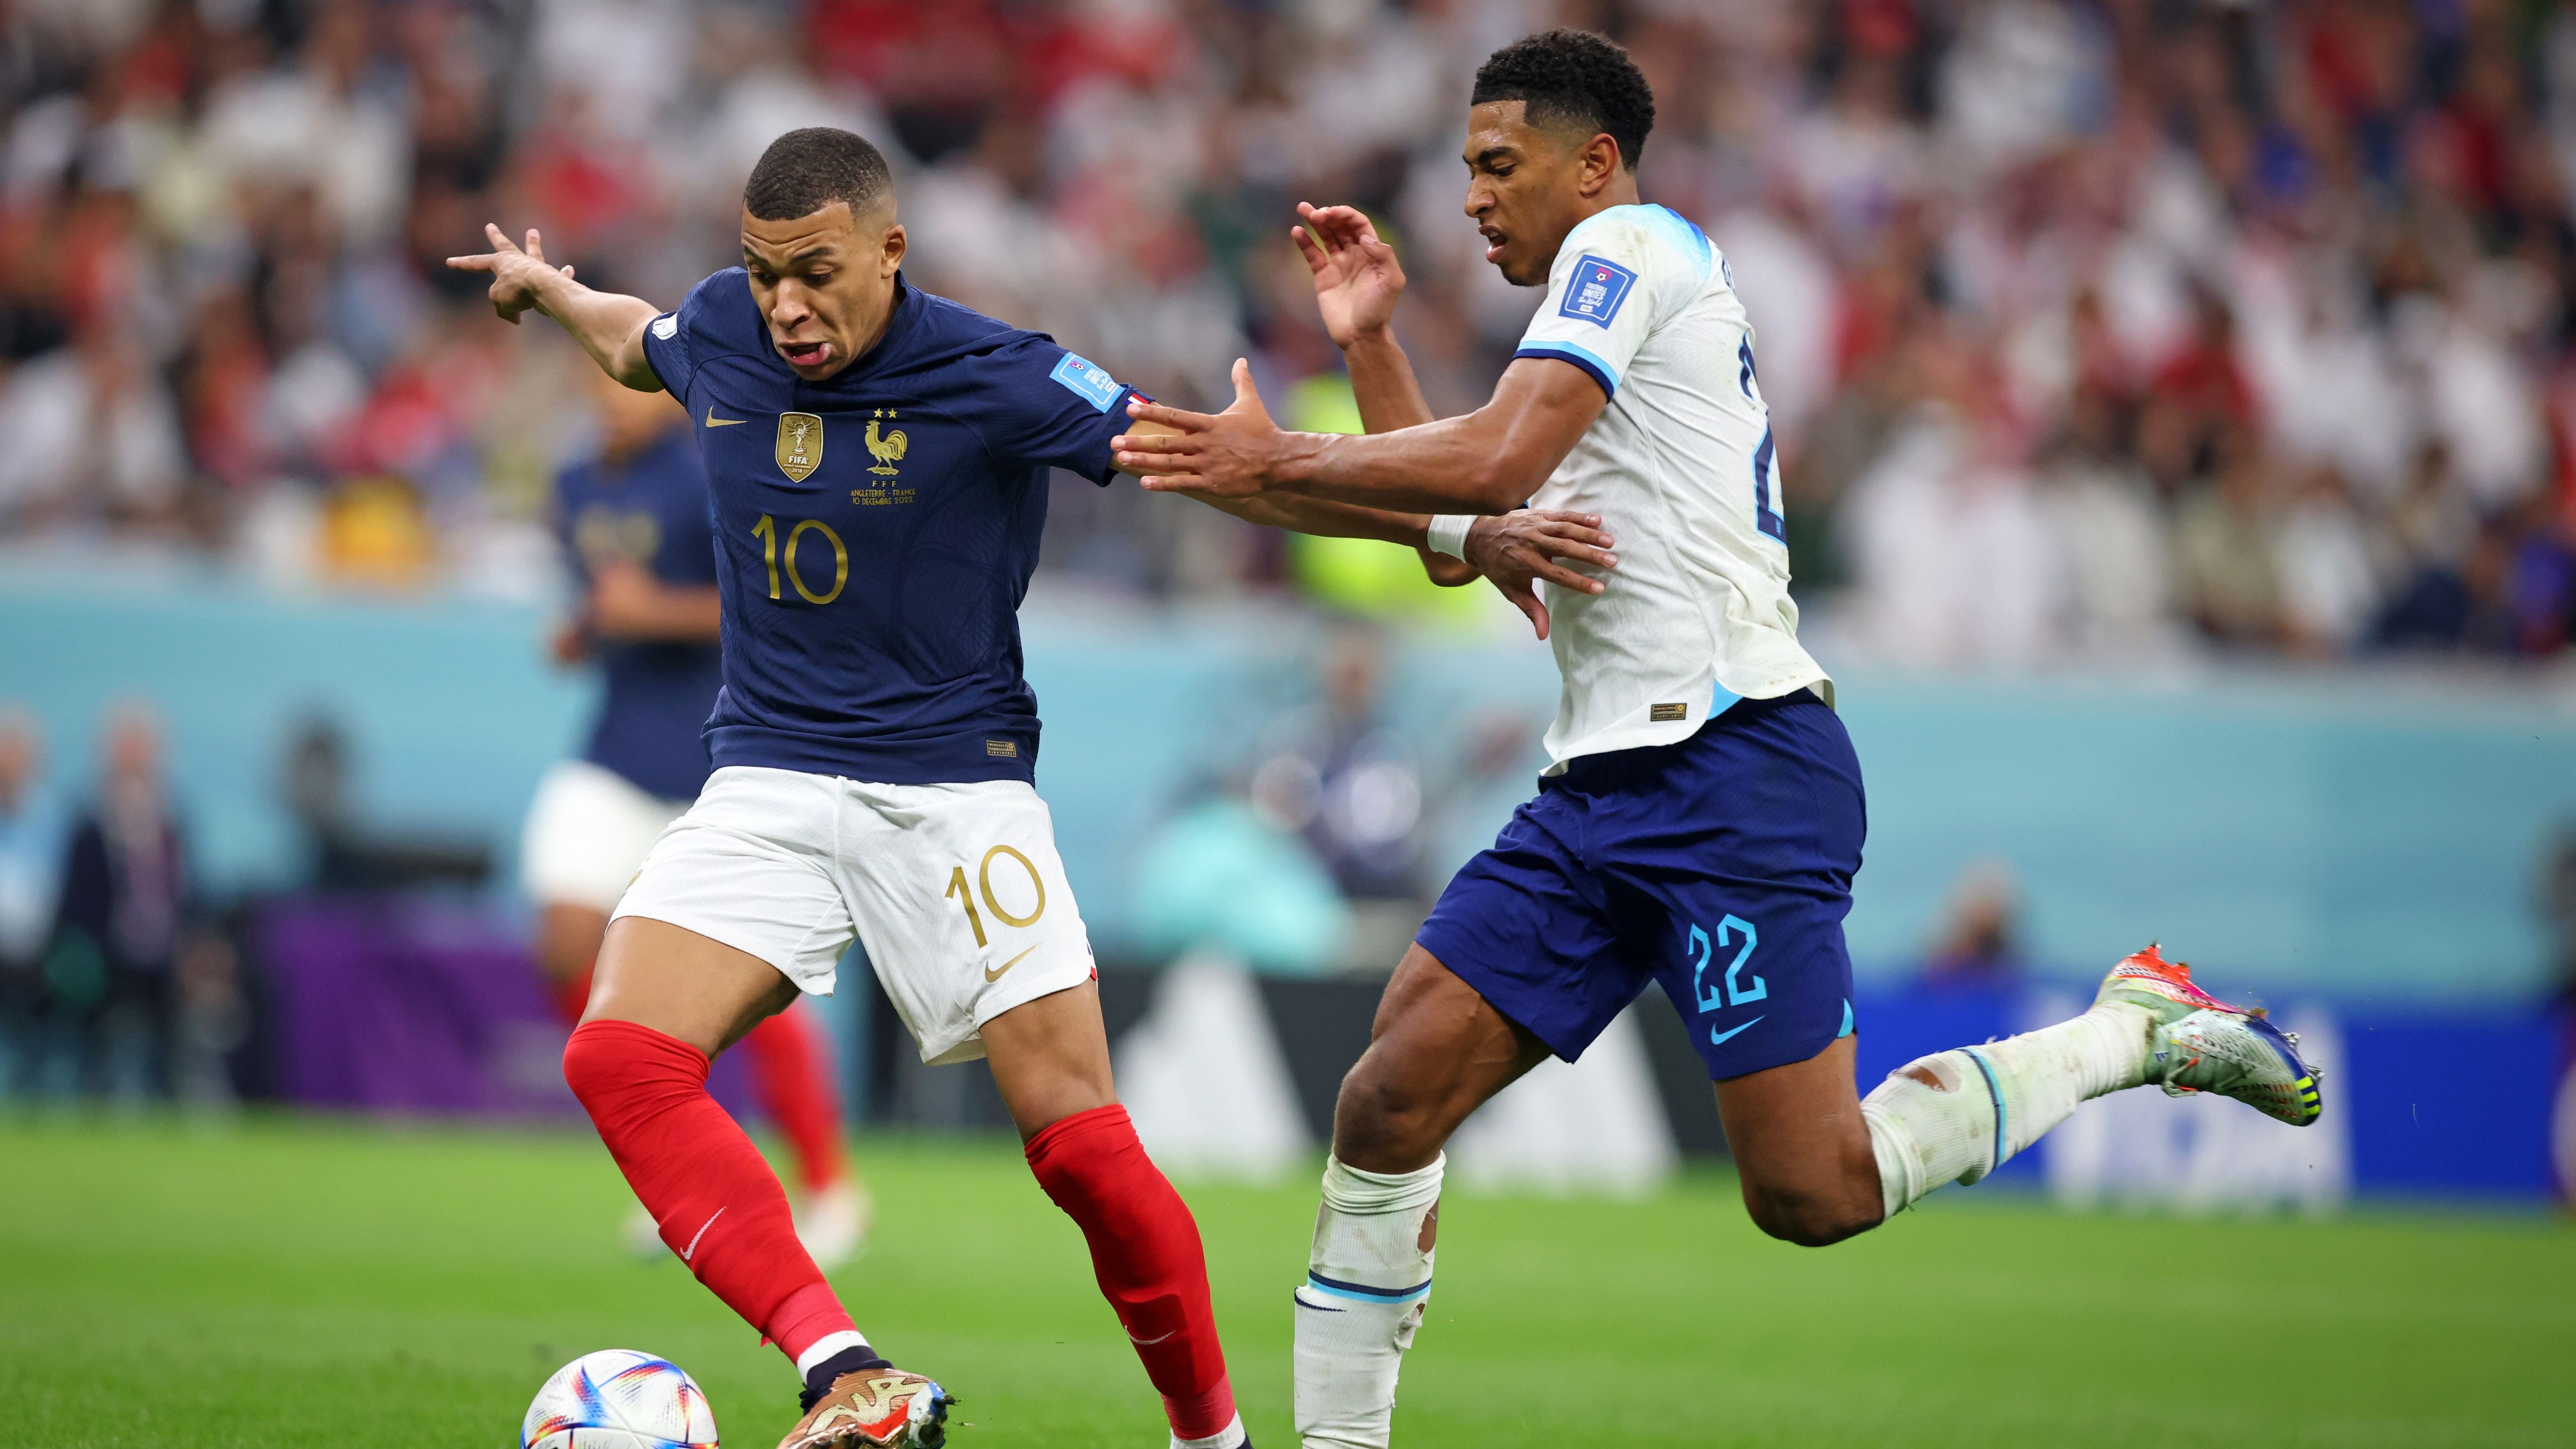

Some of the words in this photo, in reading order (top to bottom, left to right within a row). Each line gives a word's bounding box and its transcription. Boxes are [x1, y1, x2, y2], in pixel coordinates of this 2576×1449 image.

[789, 455, 808, 464] FIFA
[893, 489, 916, 497] FRANCE
[894, 496, 914, 504] 2022
[751, 512, 849, 604] 10
[945, 845, 1045, 948] 10
[1688, 914, 1767, 1013] 22
